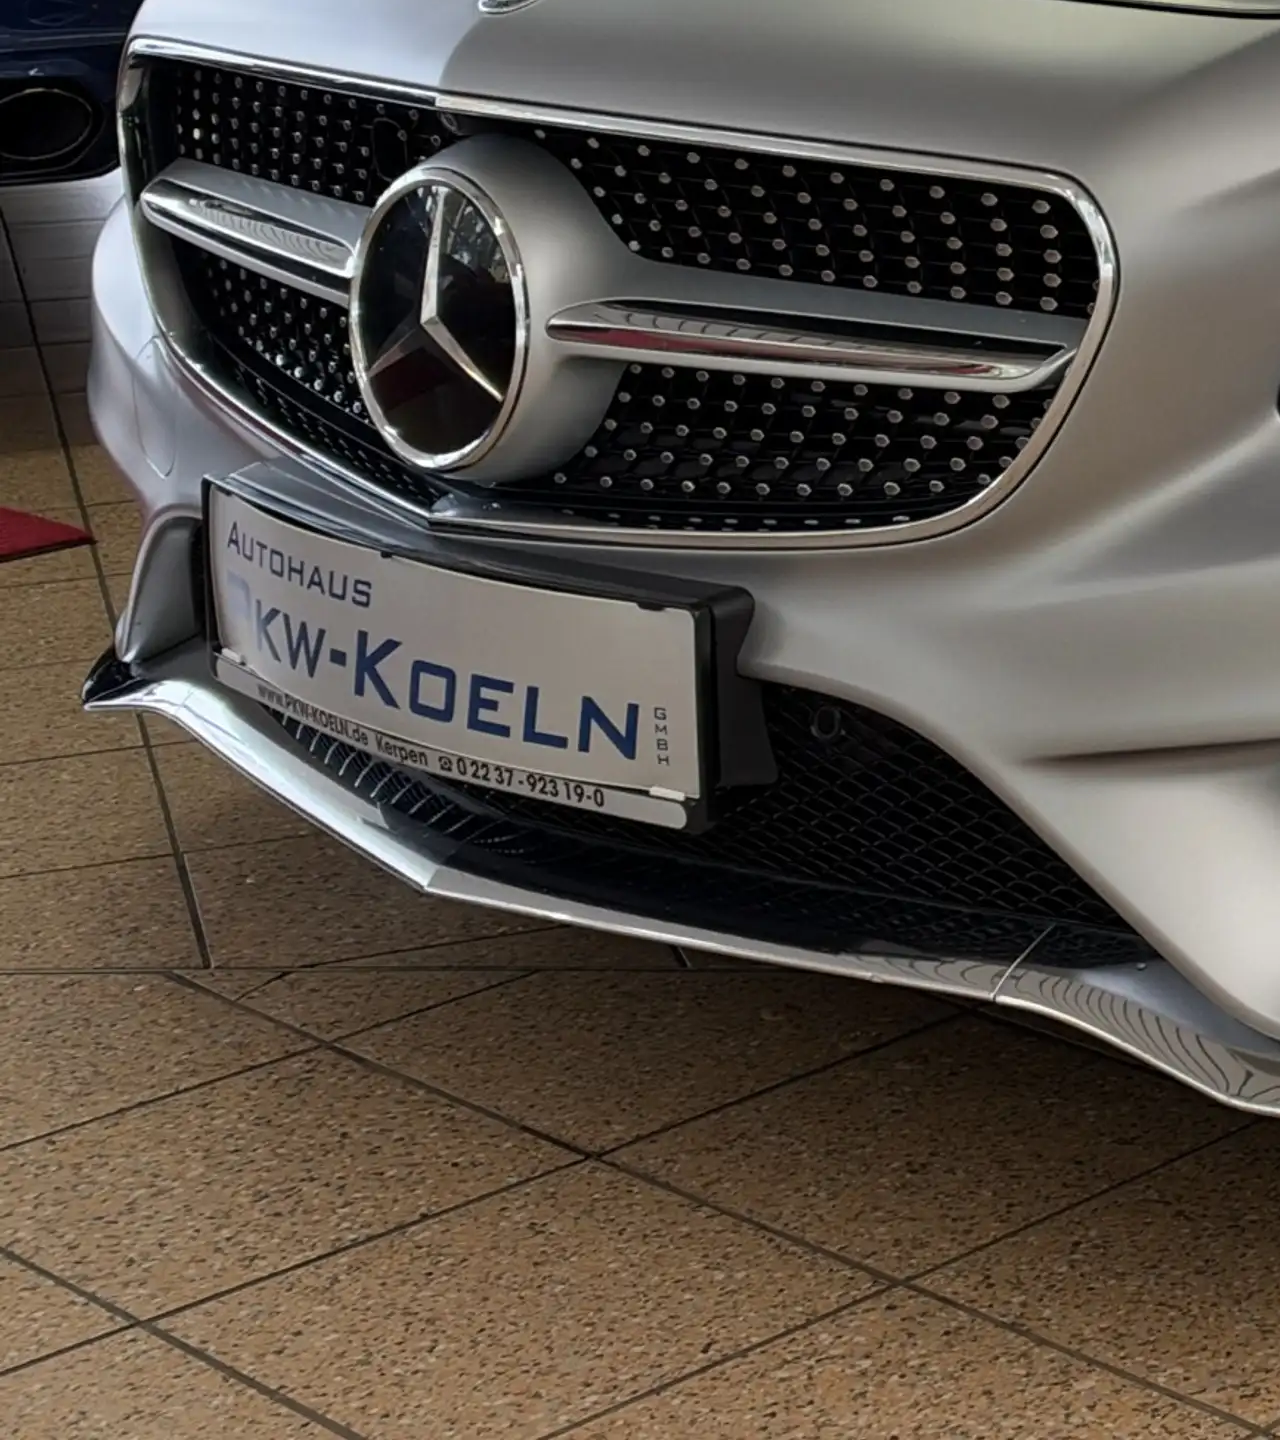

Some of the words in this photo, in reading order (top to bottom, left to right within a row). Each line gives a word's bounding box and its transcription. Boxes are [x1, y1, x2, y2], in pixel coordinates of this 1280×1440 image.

[227, 521, 372, 608] AUTOHAUS
[375, 734, 428, 766] Kerpen
[654, 706, 670, 766] GMBH
